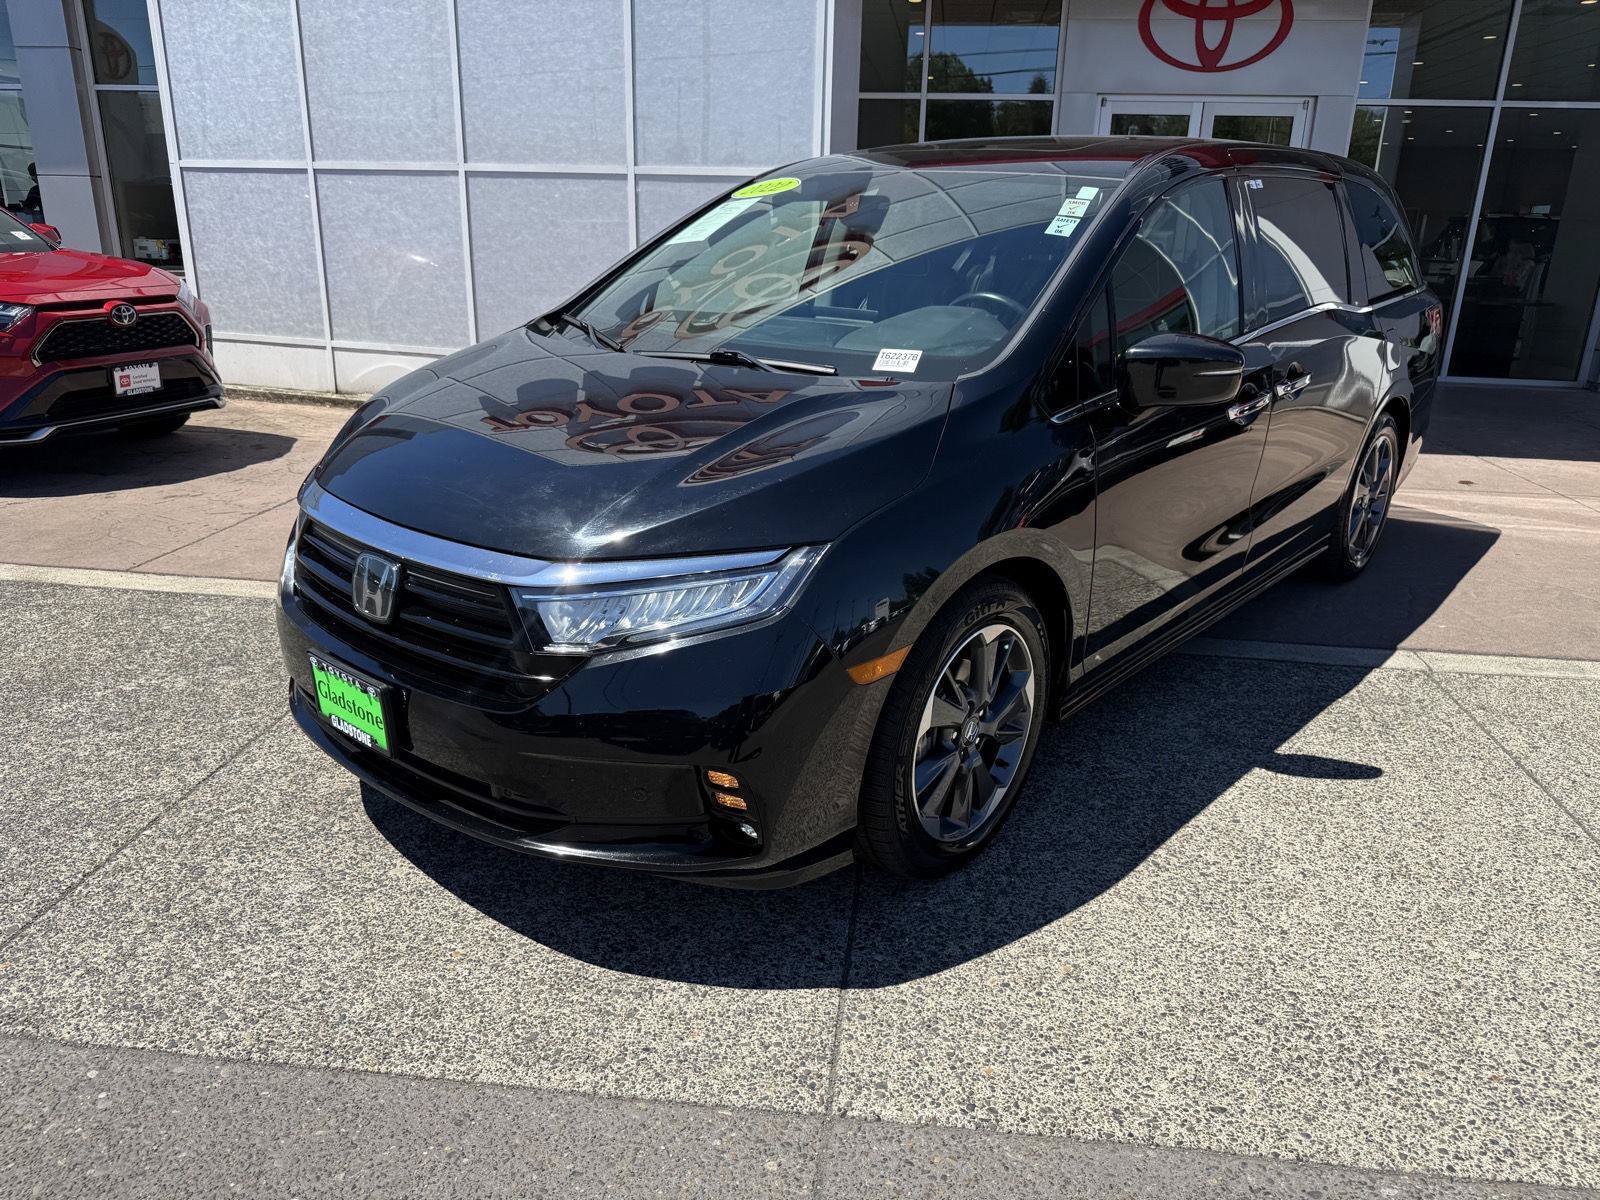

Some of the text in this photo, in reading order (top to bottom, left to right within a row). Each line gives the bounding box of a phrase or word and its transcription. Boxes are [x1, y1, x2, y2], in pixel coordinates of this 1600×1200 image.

[126, 387, 153, 395] GLADSTONE
[322, 662, 360, 688] TOYOTA
[317, 679, 384, 730] Gladstone
[330, 714, 372, 747] GLADSTONE
